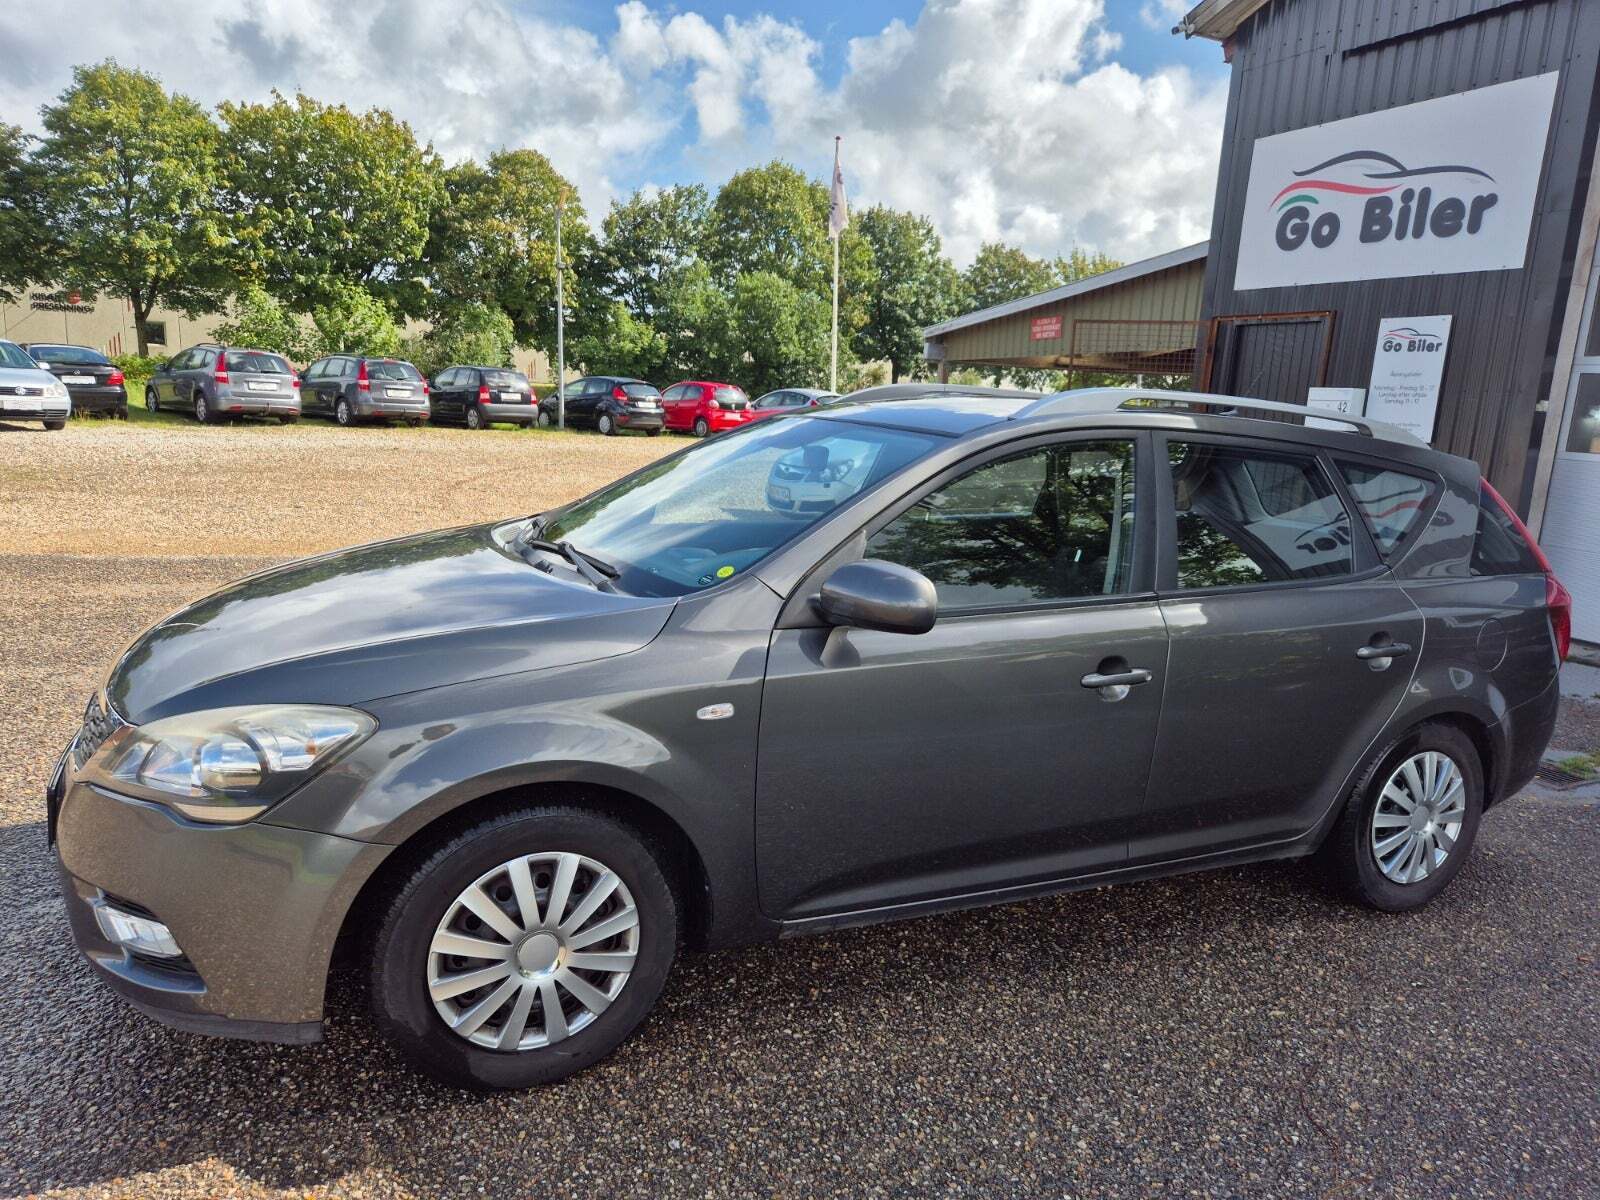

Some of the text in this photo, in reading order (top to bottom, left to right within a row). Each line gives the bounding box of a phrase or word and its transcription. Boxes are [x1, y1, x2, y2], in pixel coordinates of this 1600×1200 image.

[1275, 186, 1499, 252] Go Biler
[1383, 338, 1442, 352] Go Biler
[1337, 401, 1348, 413] 42
